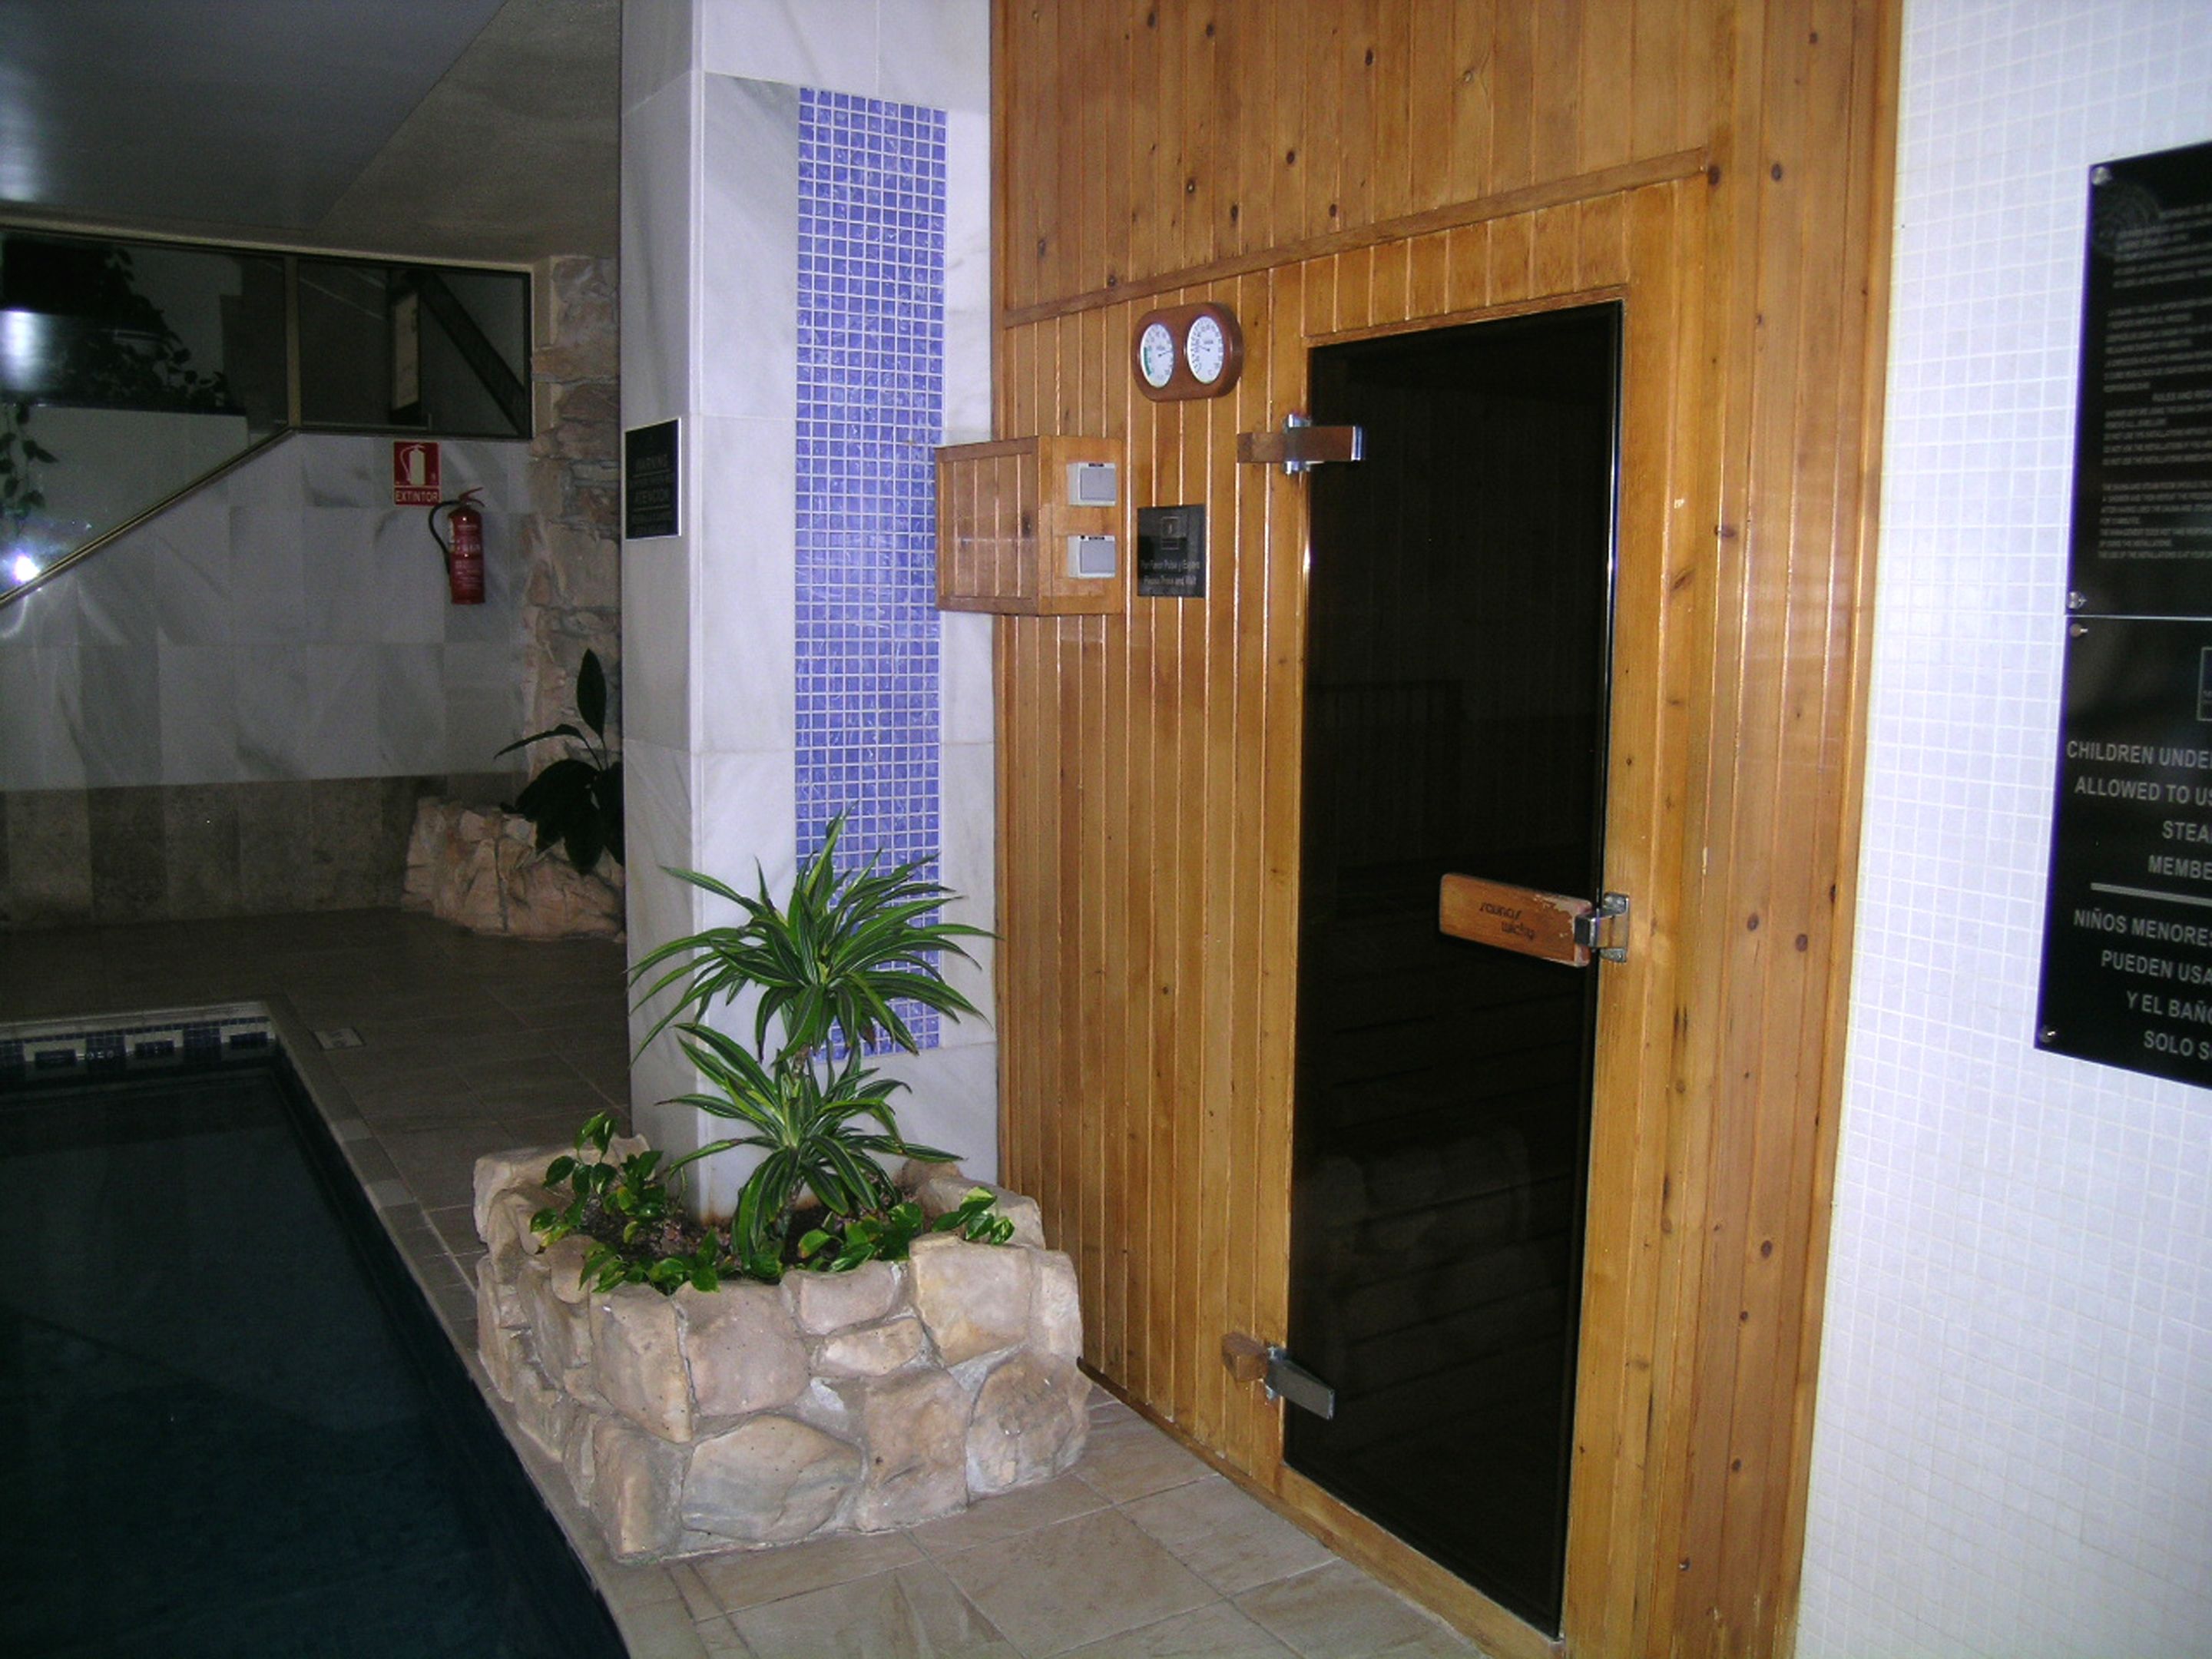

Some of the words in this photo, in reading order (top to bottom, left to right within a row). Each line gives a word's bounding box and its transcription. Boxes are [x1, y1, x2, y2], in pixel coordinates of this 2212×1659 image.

[396, 490, 438, 503] EXTINTOR
[2066, 740, 2154, 764] CHILDREN
[2159, 747, 2212, 769] UNDE
[2075, 776, 2160, 801] ALLOWED
[2166, 783, 2190, 803] TO
[2161, 820, 2212, 843] STEA
[2147, 854, 2212, 881] MEMBE
[2074, 907, 2127, 934] NIÑOS
[2131, 917, 2212, 948] MENORE
[2101, 949, 2172, 979] PUEDEN
[2126, 989, 2139, 1009] Y
[2141, 994, 2163, 1015] EL
[2144, 1029, 2194, 1056] SOLO
[2198, 1041, 2212, 1060] S
